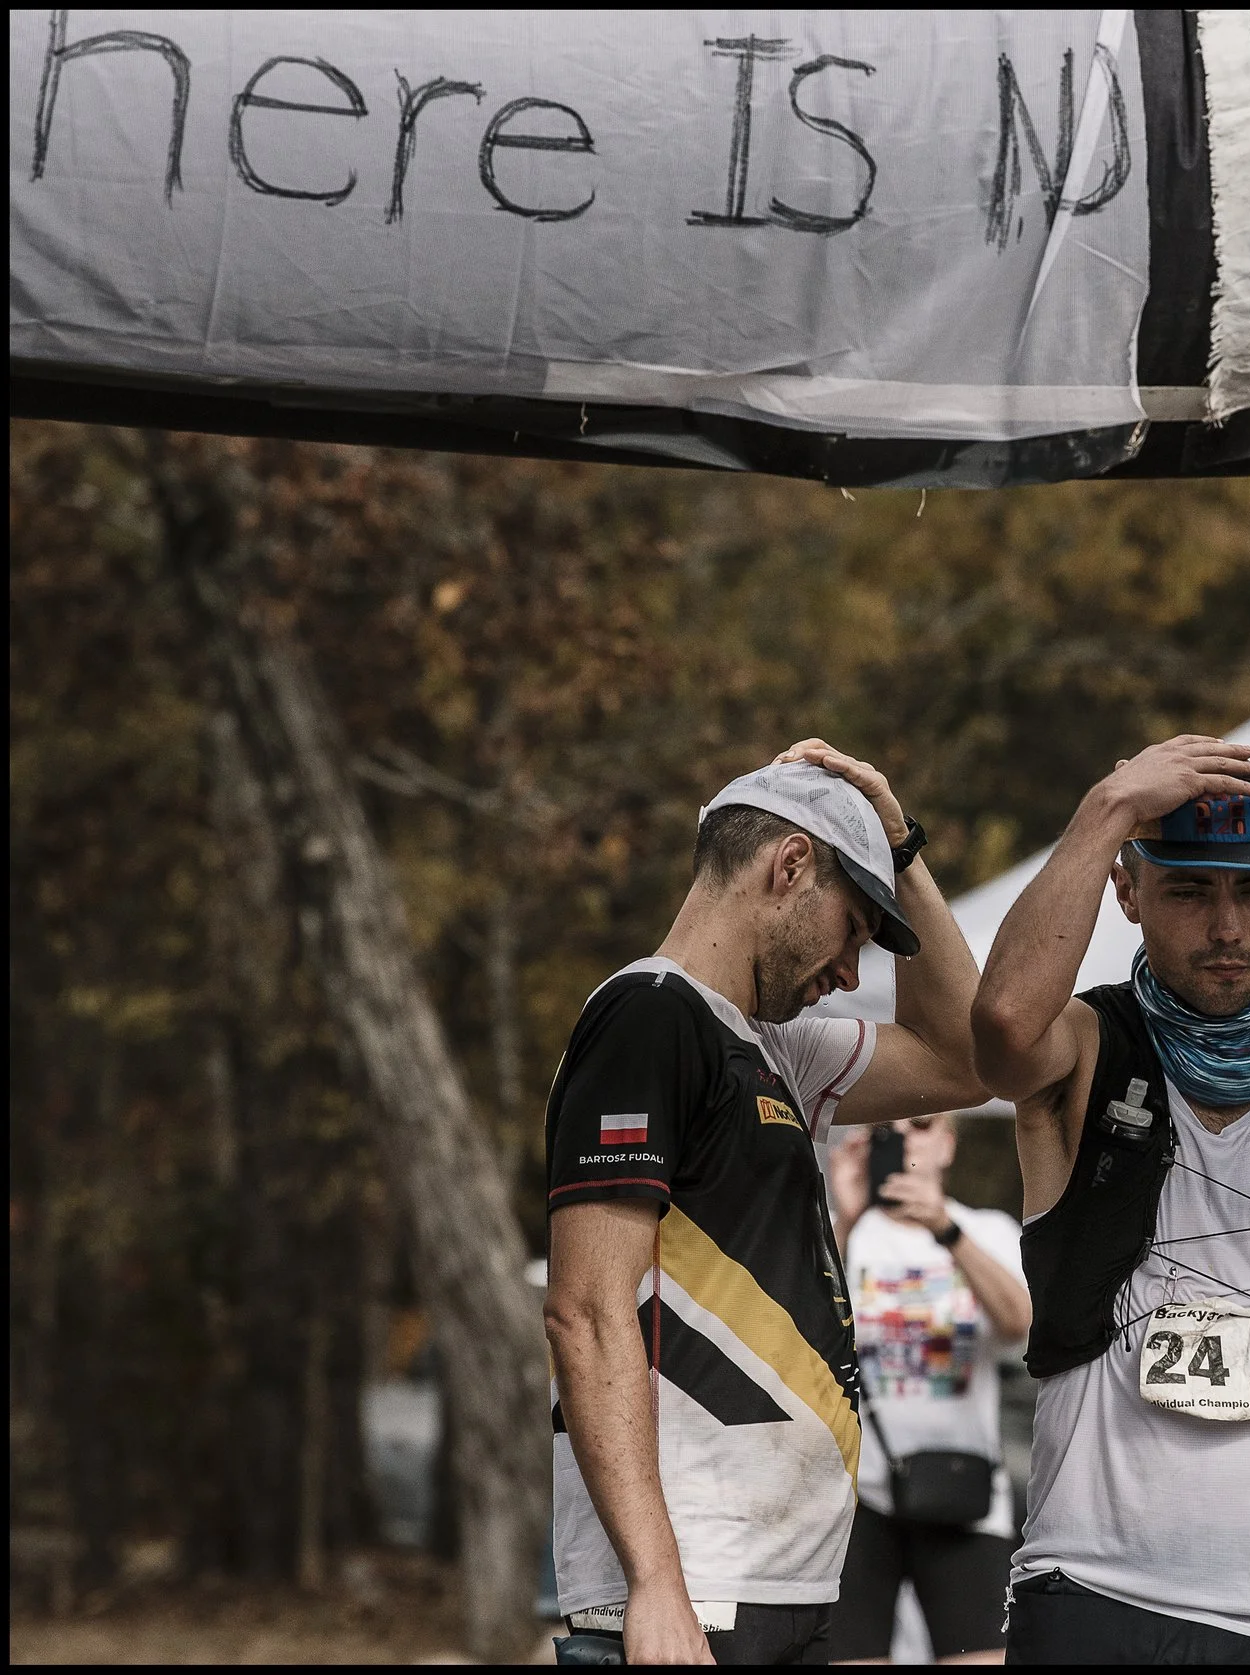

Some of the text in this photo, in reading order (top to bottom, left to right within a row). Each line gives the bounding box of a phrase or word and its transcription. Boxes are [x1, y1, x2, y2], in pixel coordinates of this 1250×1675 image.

[684, 33, 877, 238] IS
[579, 1153, 664, 1165] BARTOSZ FUDALI
[1154, 1308, 1226, 1322] Backyar
[1146, 1330, 1230, 1386] 24
[591, 1606, 625, 1618] Individ
